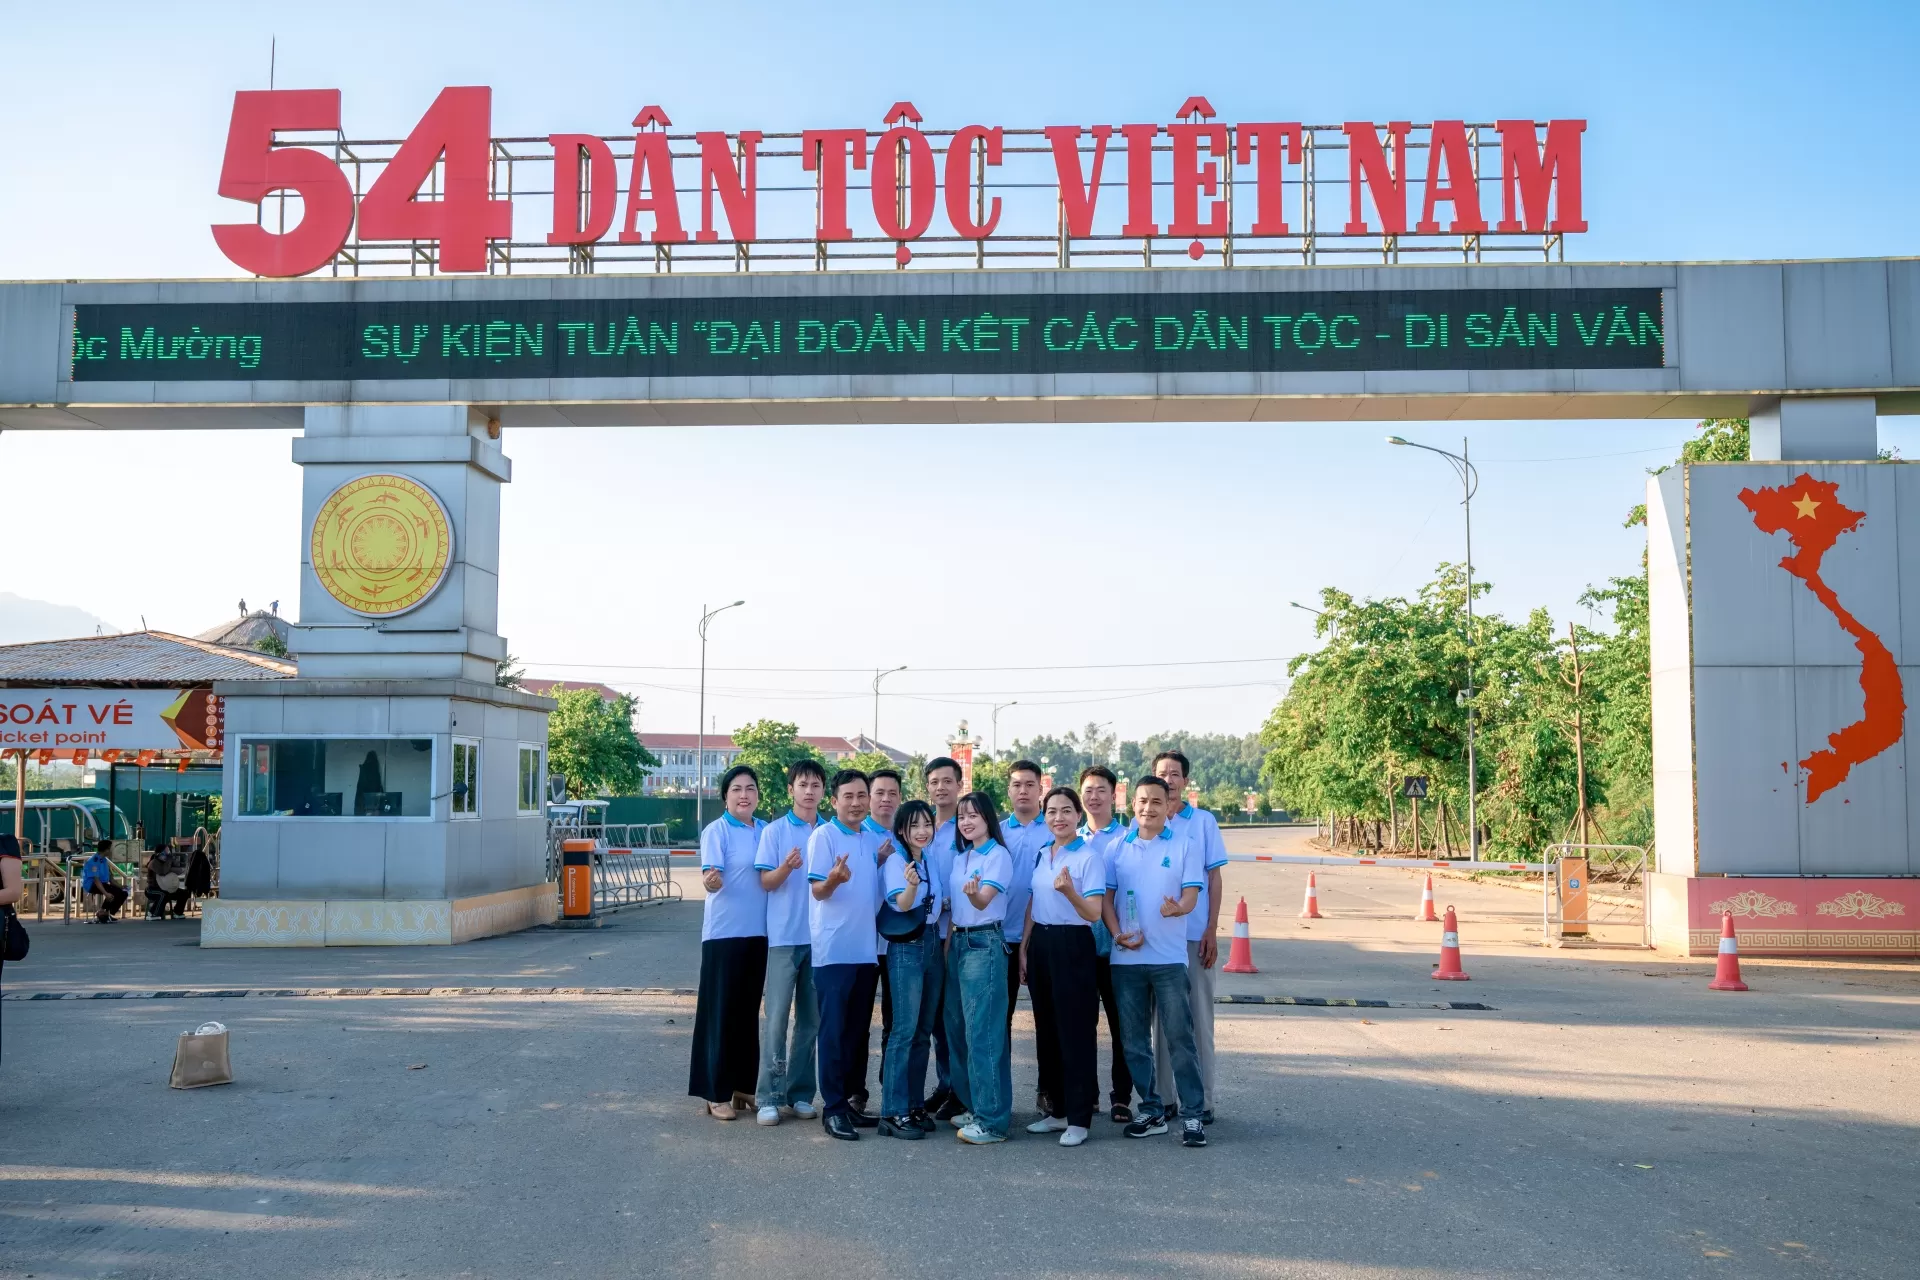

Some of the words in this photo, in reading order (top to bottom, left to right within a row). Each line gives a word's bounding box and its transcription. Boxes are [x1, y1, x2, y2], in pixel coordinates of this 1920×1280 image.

[211, 86, 513, 277] 54
[547, 105, 763, 245] DÂN
[801, 102, 1004, 264] TỘC
[1044, 96, 1303, 260] VIỆT
[1343, 119, 1588, 236] NAM
[120, 326, 262, 368] Mường
[362, 323, 429, 363] SỰ
[442, 320, 543, 362] KIỆN
[795, 313, 926, 353] ĐOÀN
[1043, 311, 1138, 351] CÁC
[1154, 310, 1248, 350] DÂN
[1263, 311, 1361, 355] TỘC
[1405, 313, 1449, 348] DI
[1572, 306, 1665, 346] VĂN
[88, 698, 134, 725] VÉ
[56, 731, 107, 746] point
